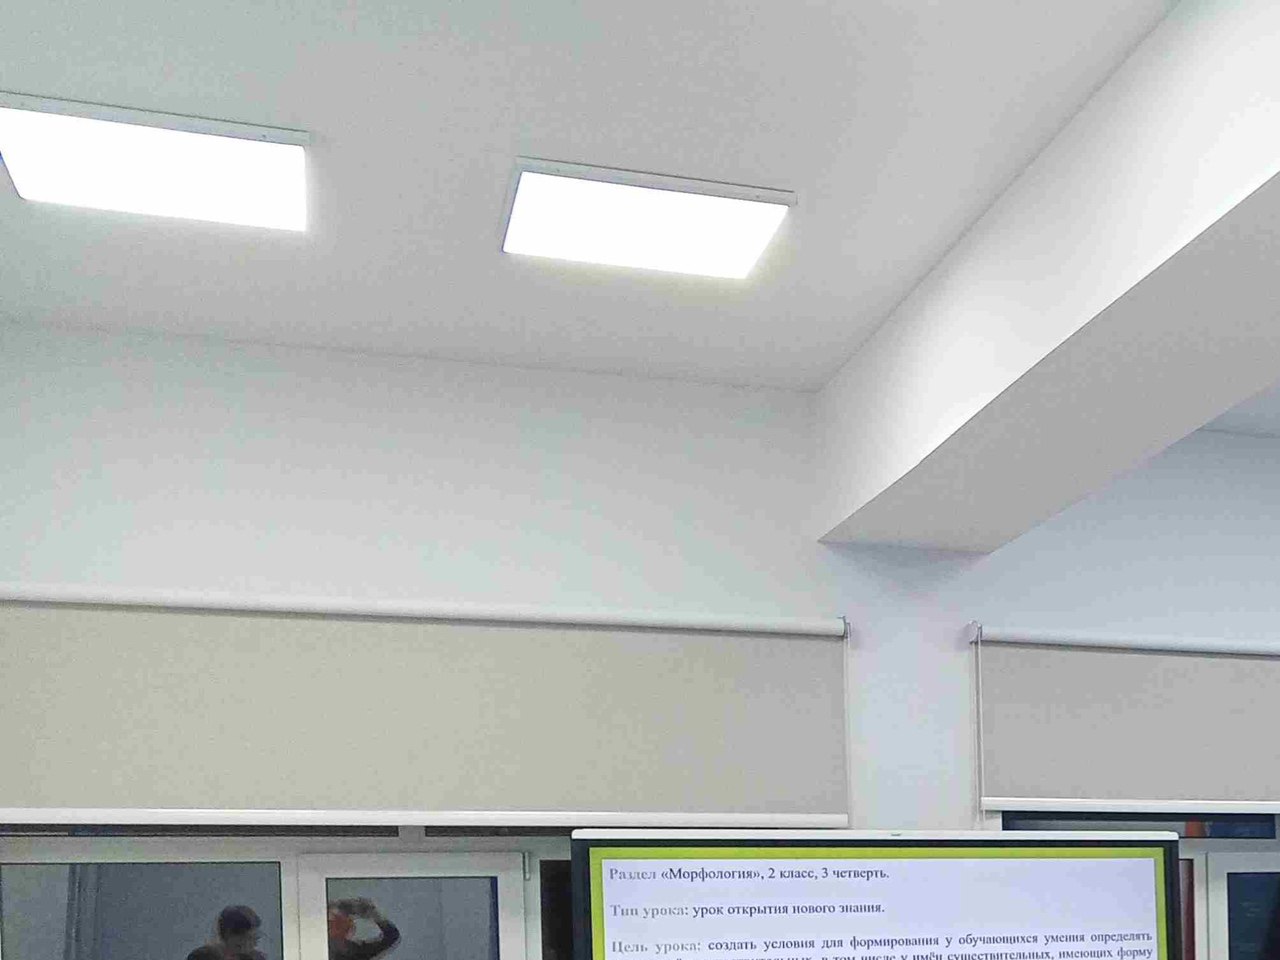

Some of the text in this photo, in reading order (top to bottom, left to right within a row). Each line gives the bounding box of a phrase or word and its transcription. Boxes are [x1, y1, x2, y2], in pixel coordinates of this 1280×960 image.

[609, 866, 891, 881] Раздел «Морфология», 2 класс, 3 четверть.
[609, 903, 886, 918] Тип урока: урок открытия нового знания.
[611, 931, 1153, 954] Цель урока: создать условия для формирования у обучающихся умения определять
[1057, 948, 1114, 960] имеющих
[1116, 945, 1154, 960] форму
